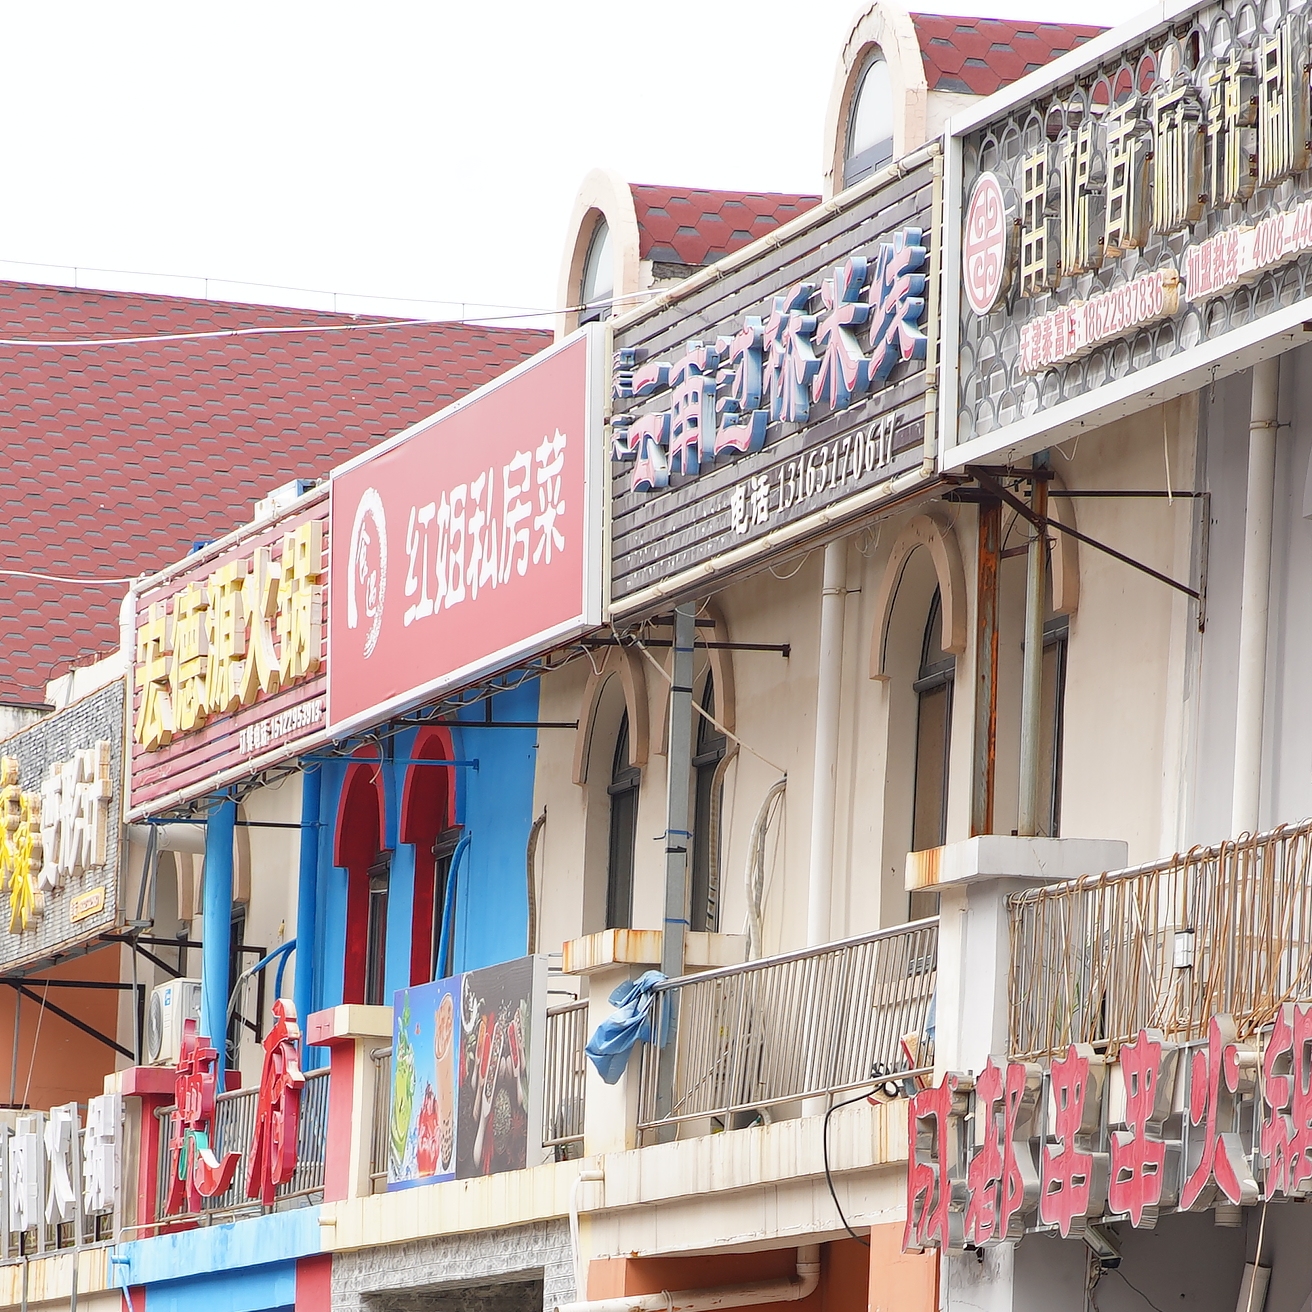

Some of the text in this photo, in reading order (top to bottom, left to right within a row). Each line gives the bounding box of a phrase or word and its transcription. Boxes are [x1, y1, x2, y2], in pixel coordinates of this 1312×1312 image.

[403, 427, 567, 628] 红姐私房菜
[730, 474, 771, 534] 电话
